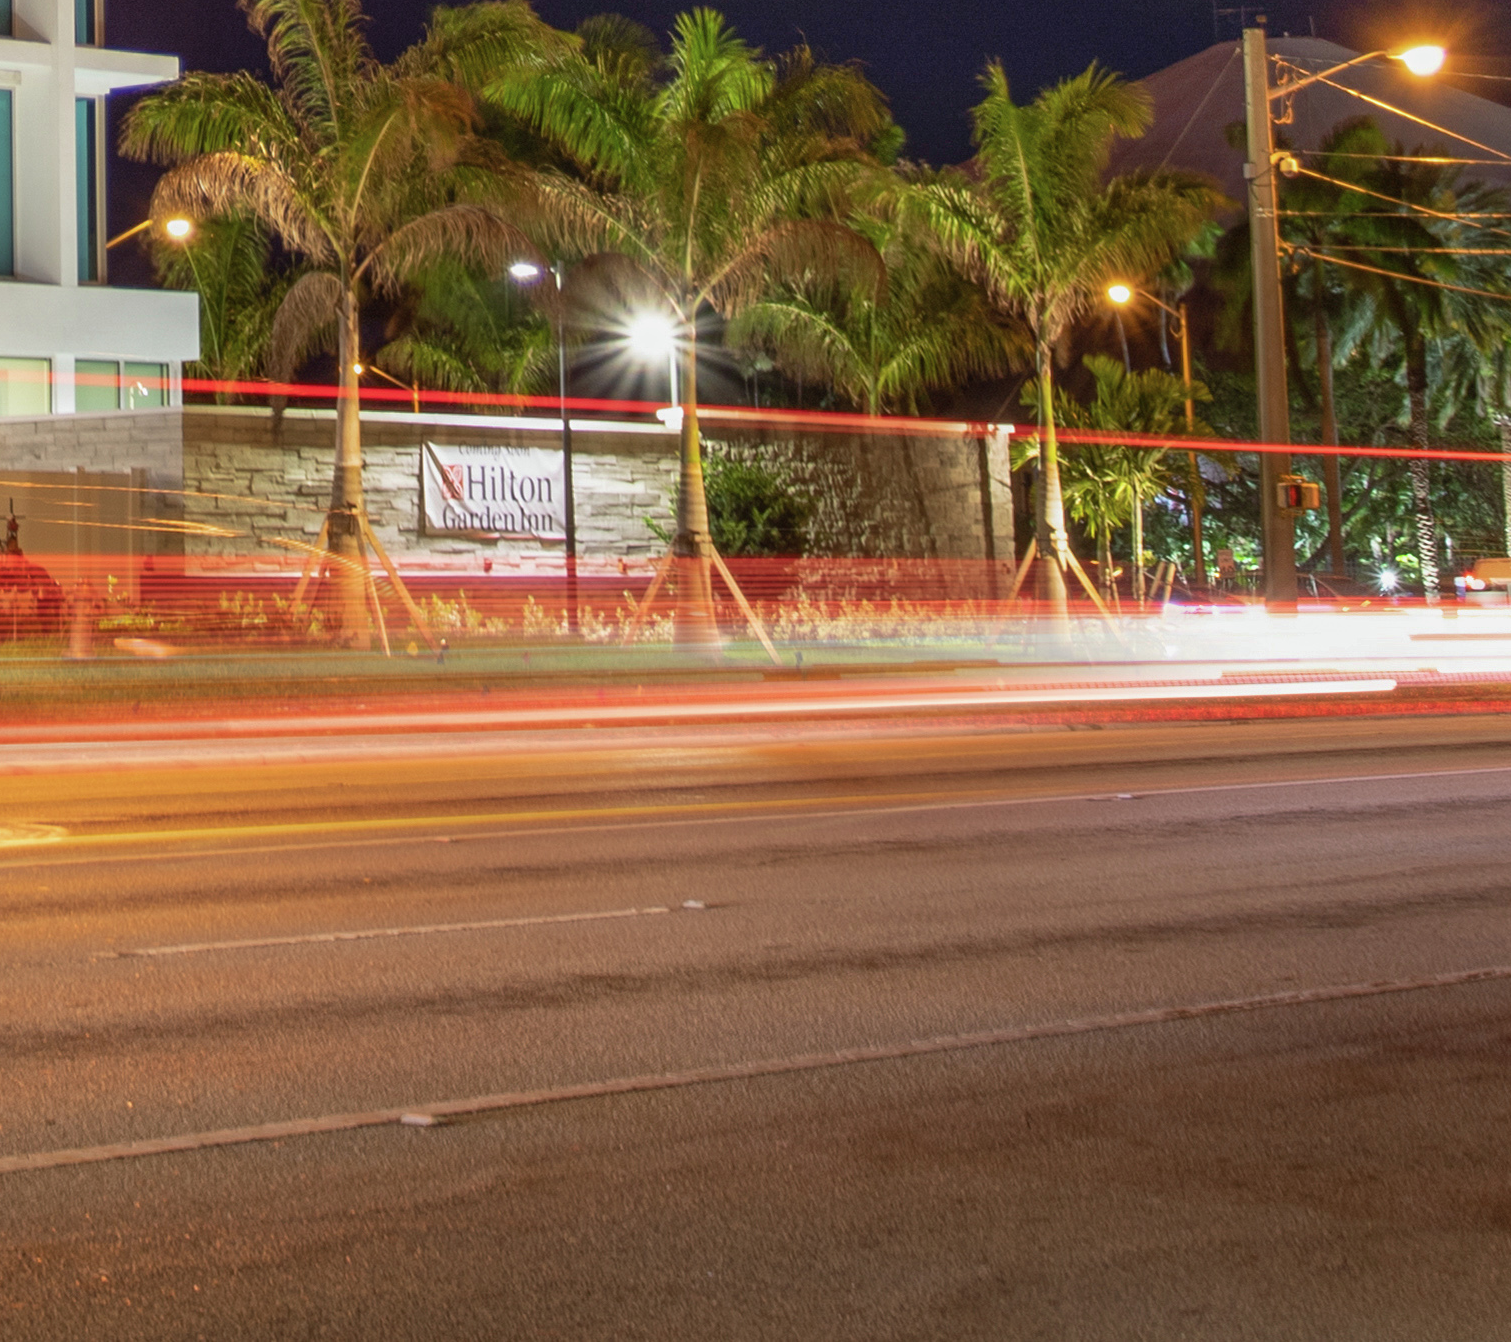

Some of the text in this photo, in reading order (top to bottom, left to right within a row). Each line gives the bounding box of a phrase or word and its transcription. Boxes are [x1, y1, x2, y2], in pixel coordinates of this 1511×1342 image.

[467, 465, 553, 503] Hilton
[443, 505, 554, 532] Garden Inn
